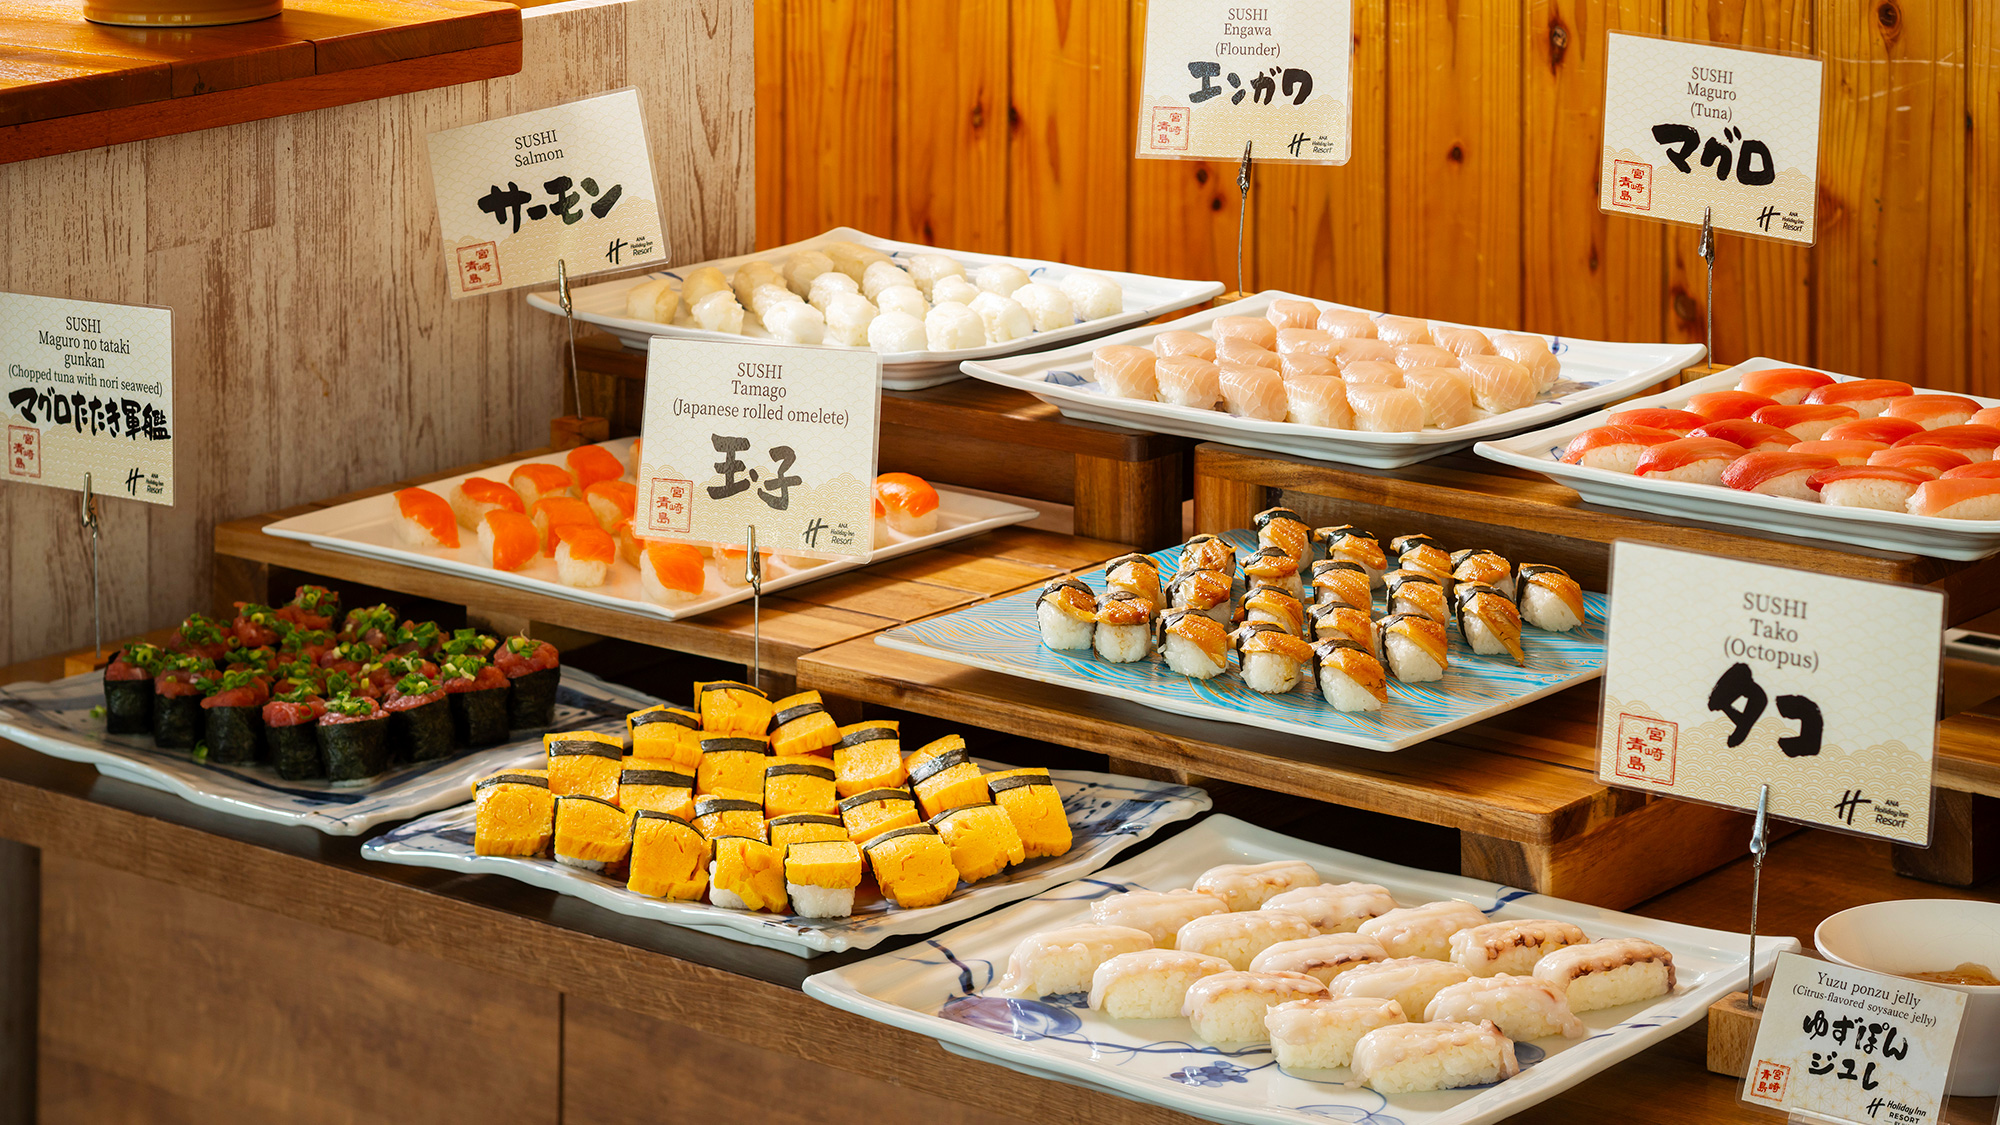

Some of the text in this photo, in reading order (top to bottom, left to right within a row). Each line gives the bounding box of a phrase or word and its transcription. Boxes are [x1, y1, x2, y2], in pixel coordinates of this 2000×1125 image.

[1228, 8, 1268, 20] SUSHI
[1224, 23, 1271, 39] Engawa
[1215, 42, 1280, 58] (Flounder)
[1188, 61, 1313, 105] エンガワ
[1691, 67, 1733, 84] SUSHI
[1687, 82, 1736, 101] Maguro
[1690, 102, 1733, 123] (Tuna)
[514, 130, 558, 150] SUSHI
[514, 148, 564, 167] Salmon
[1652, 124, 1775, 186] マグロ
[478, 176, 622, 234] サーモン
[66, 316, 101, 334] SUSHI
[39, 331, 130, 354] Maguro no tataki
[64, 352, 104, 369] gunkan
[738, 362, 782, 379] SUSHI
[9, 364, 162, 397] (Chopped tuna with nori seaweed)
[732, 380, 786, 401] Tamago
[9, 387, 171, 441] マグロたたき軍艦
[673, 398, 849, 429] (Japanese rolled omelete)
[707, 433, 802, 511] 玉子
[1743, 592, 1807, 620] SUSHI
[1750, 618, 1798, 643] Tako
[1724, 636, 1819, 673] (Octopus)
[1708, 662, 1823, 758] タコ
[1876, 814, 1906, 828] Resort
[1817, 972, 1921, 1009] Yuzu ponzu jelly
[1793, 984, 1937, 1027] (Citrus-flavored soysauce jelly)
[1803, 1010, 1908, 1060] ゆずぽん
[1887, 1100, 1926, 1117] Holiday Inn
[1889, 1112, 1920, 1124] RESORT
